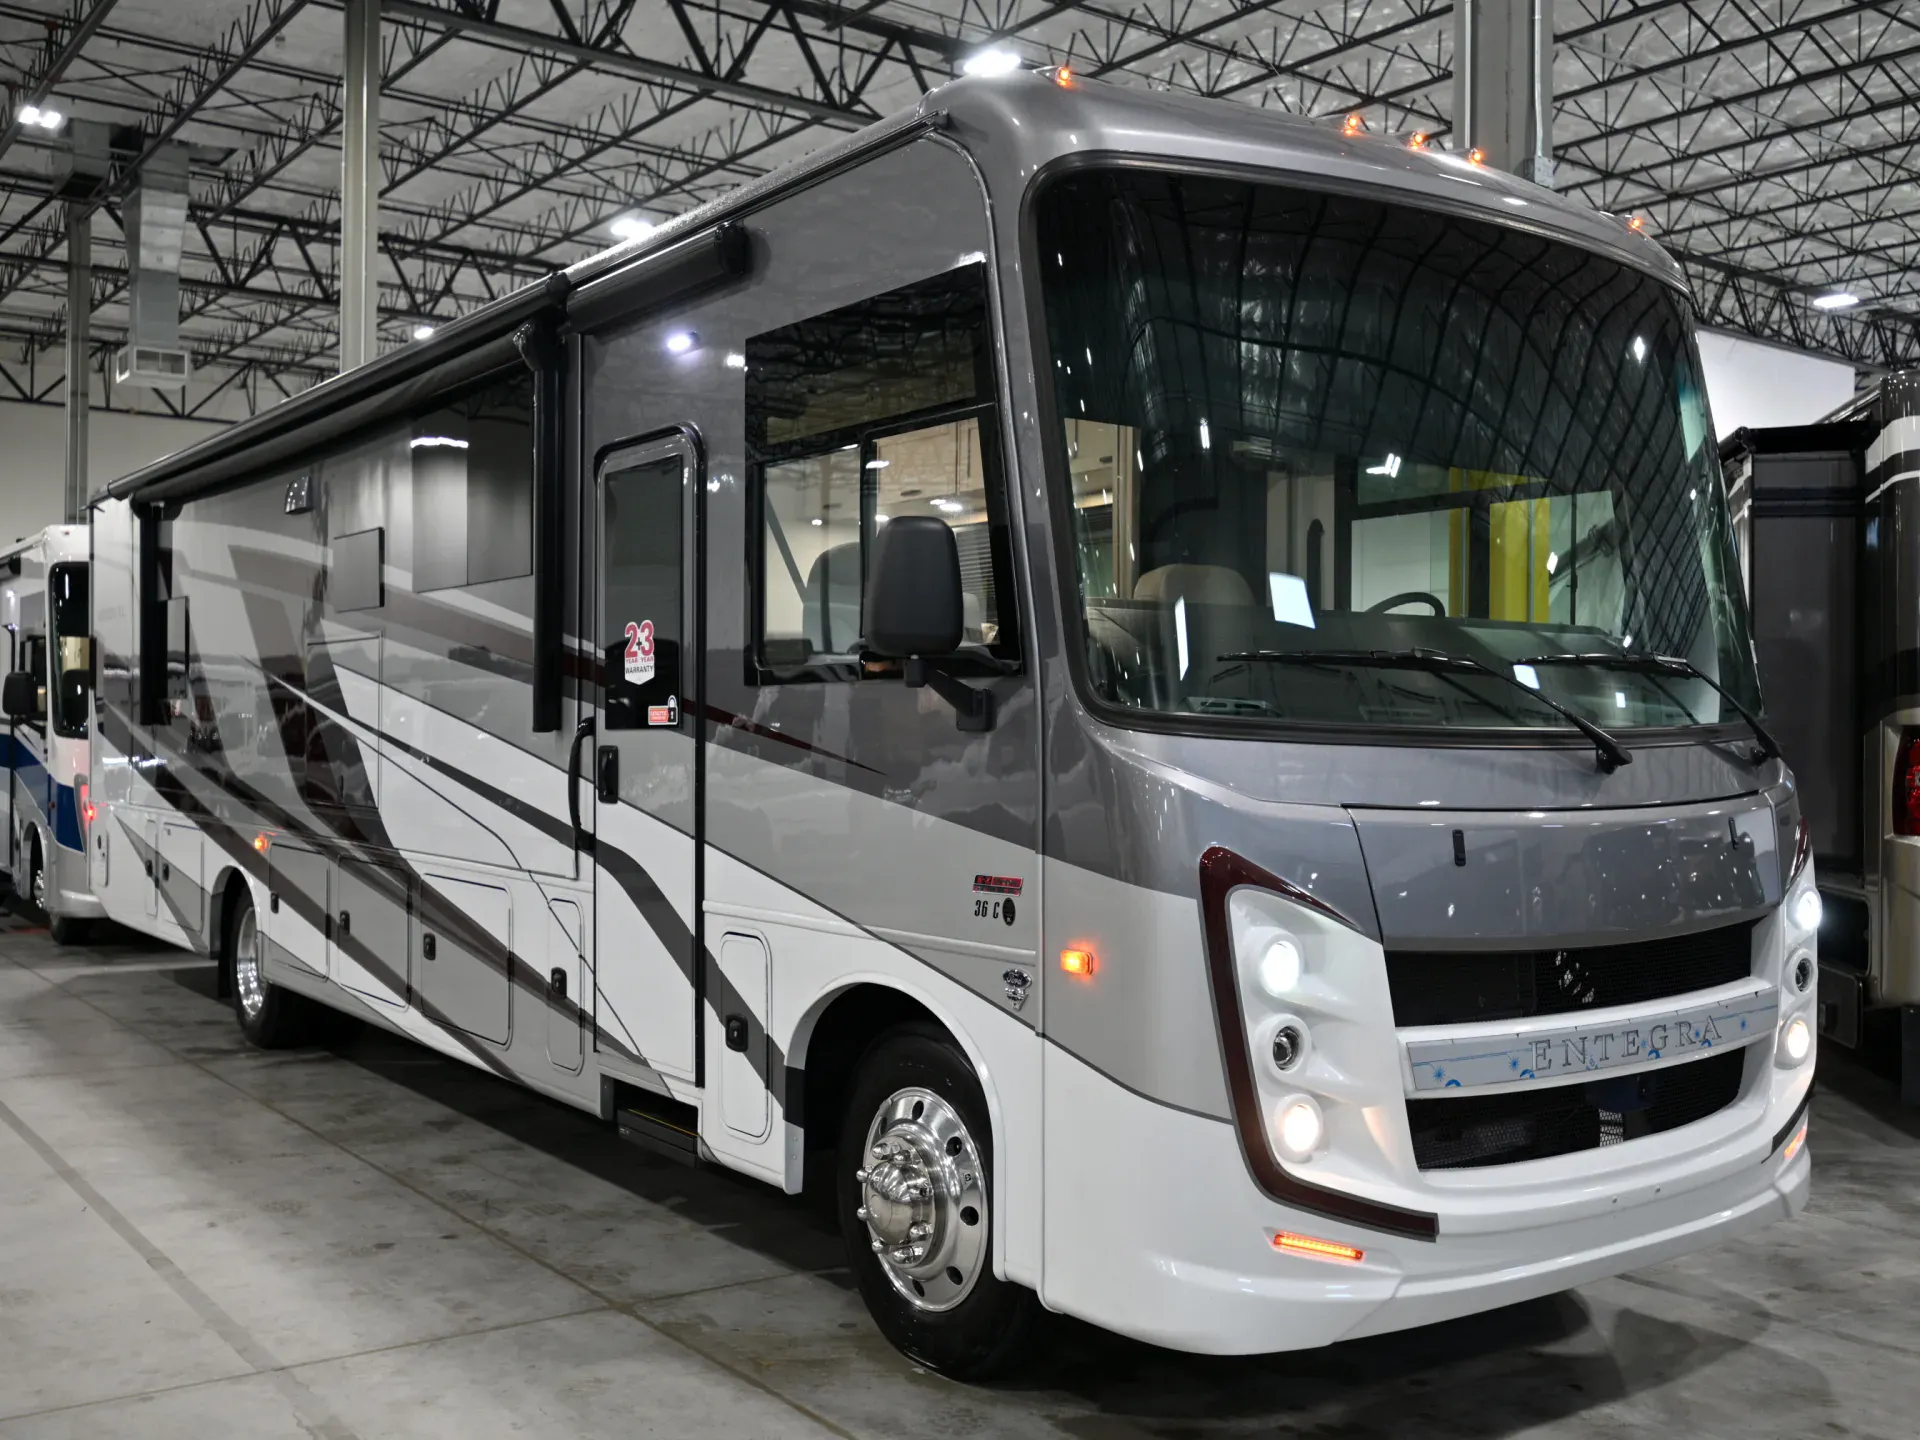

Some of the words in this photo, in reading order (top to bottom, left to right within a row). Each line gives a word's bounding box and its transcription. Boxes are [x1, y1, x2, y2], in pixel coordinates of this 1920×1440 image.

[625, 665, 653, 674] WARRANTY
[974, 899, 989, 918] 36
[993, 901, 1000, 919] C
[1529, 1015, 1722, 1071] ENTEGRA
